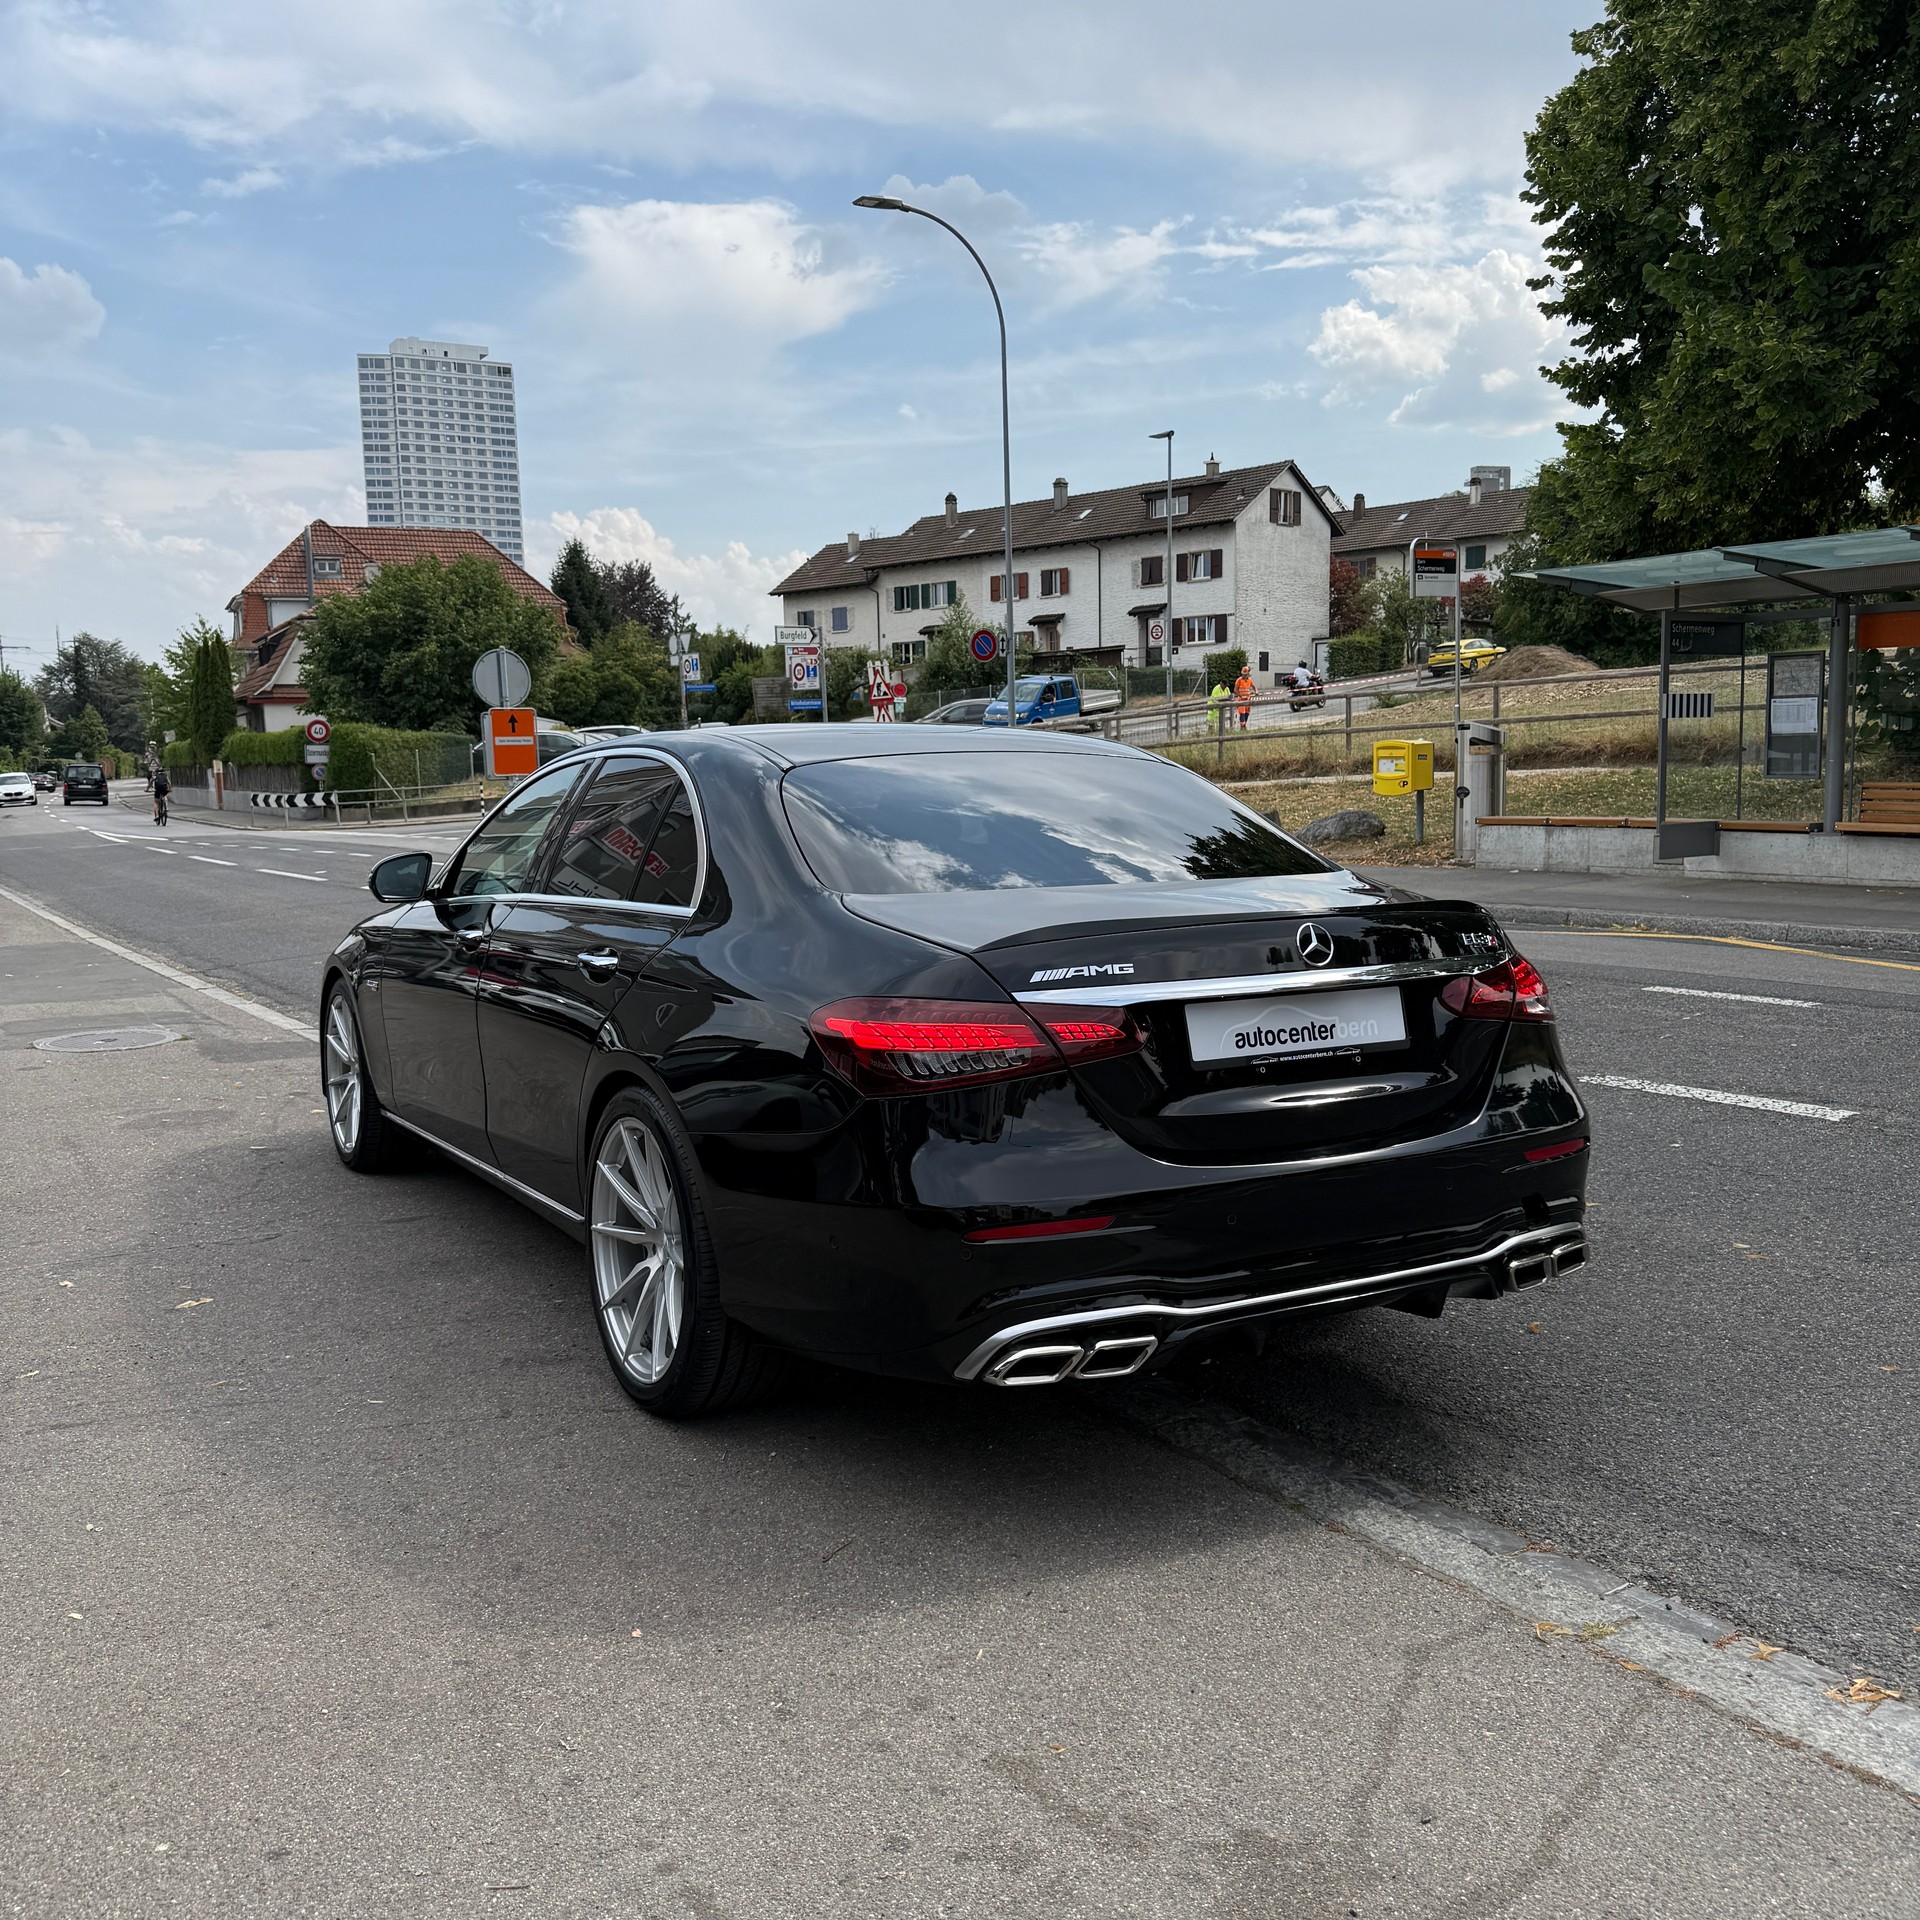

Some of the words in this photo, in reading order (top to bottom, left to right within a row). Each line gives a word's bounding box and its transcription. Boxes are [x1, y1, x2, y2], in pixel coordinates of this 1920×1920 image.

[780, 630, 807, 641] Burgfeld
[1672, 623, 1715, 636] Schermenweg
[314, 727, 324, 735] 40
[1065, 963, 1135, 979] AMG
